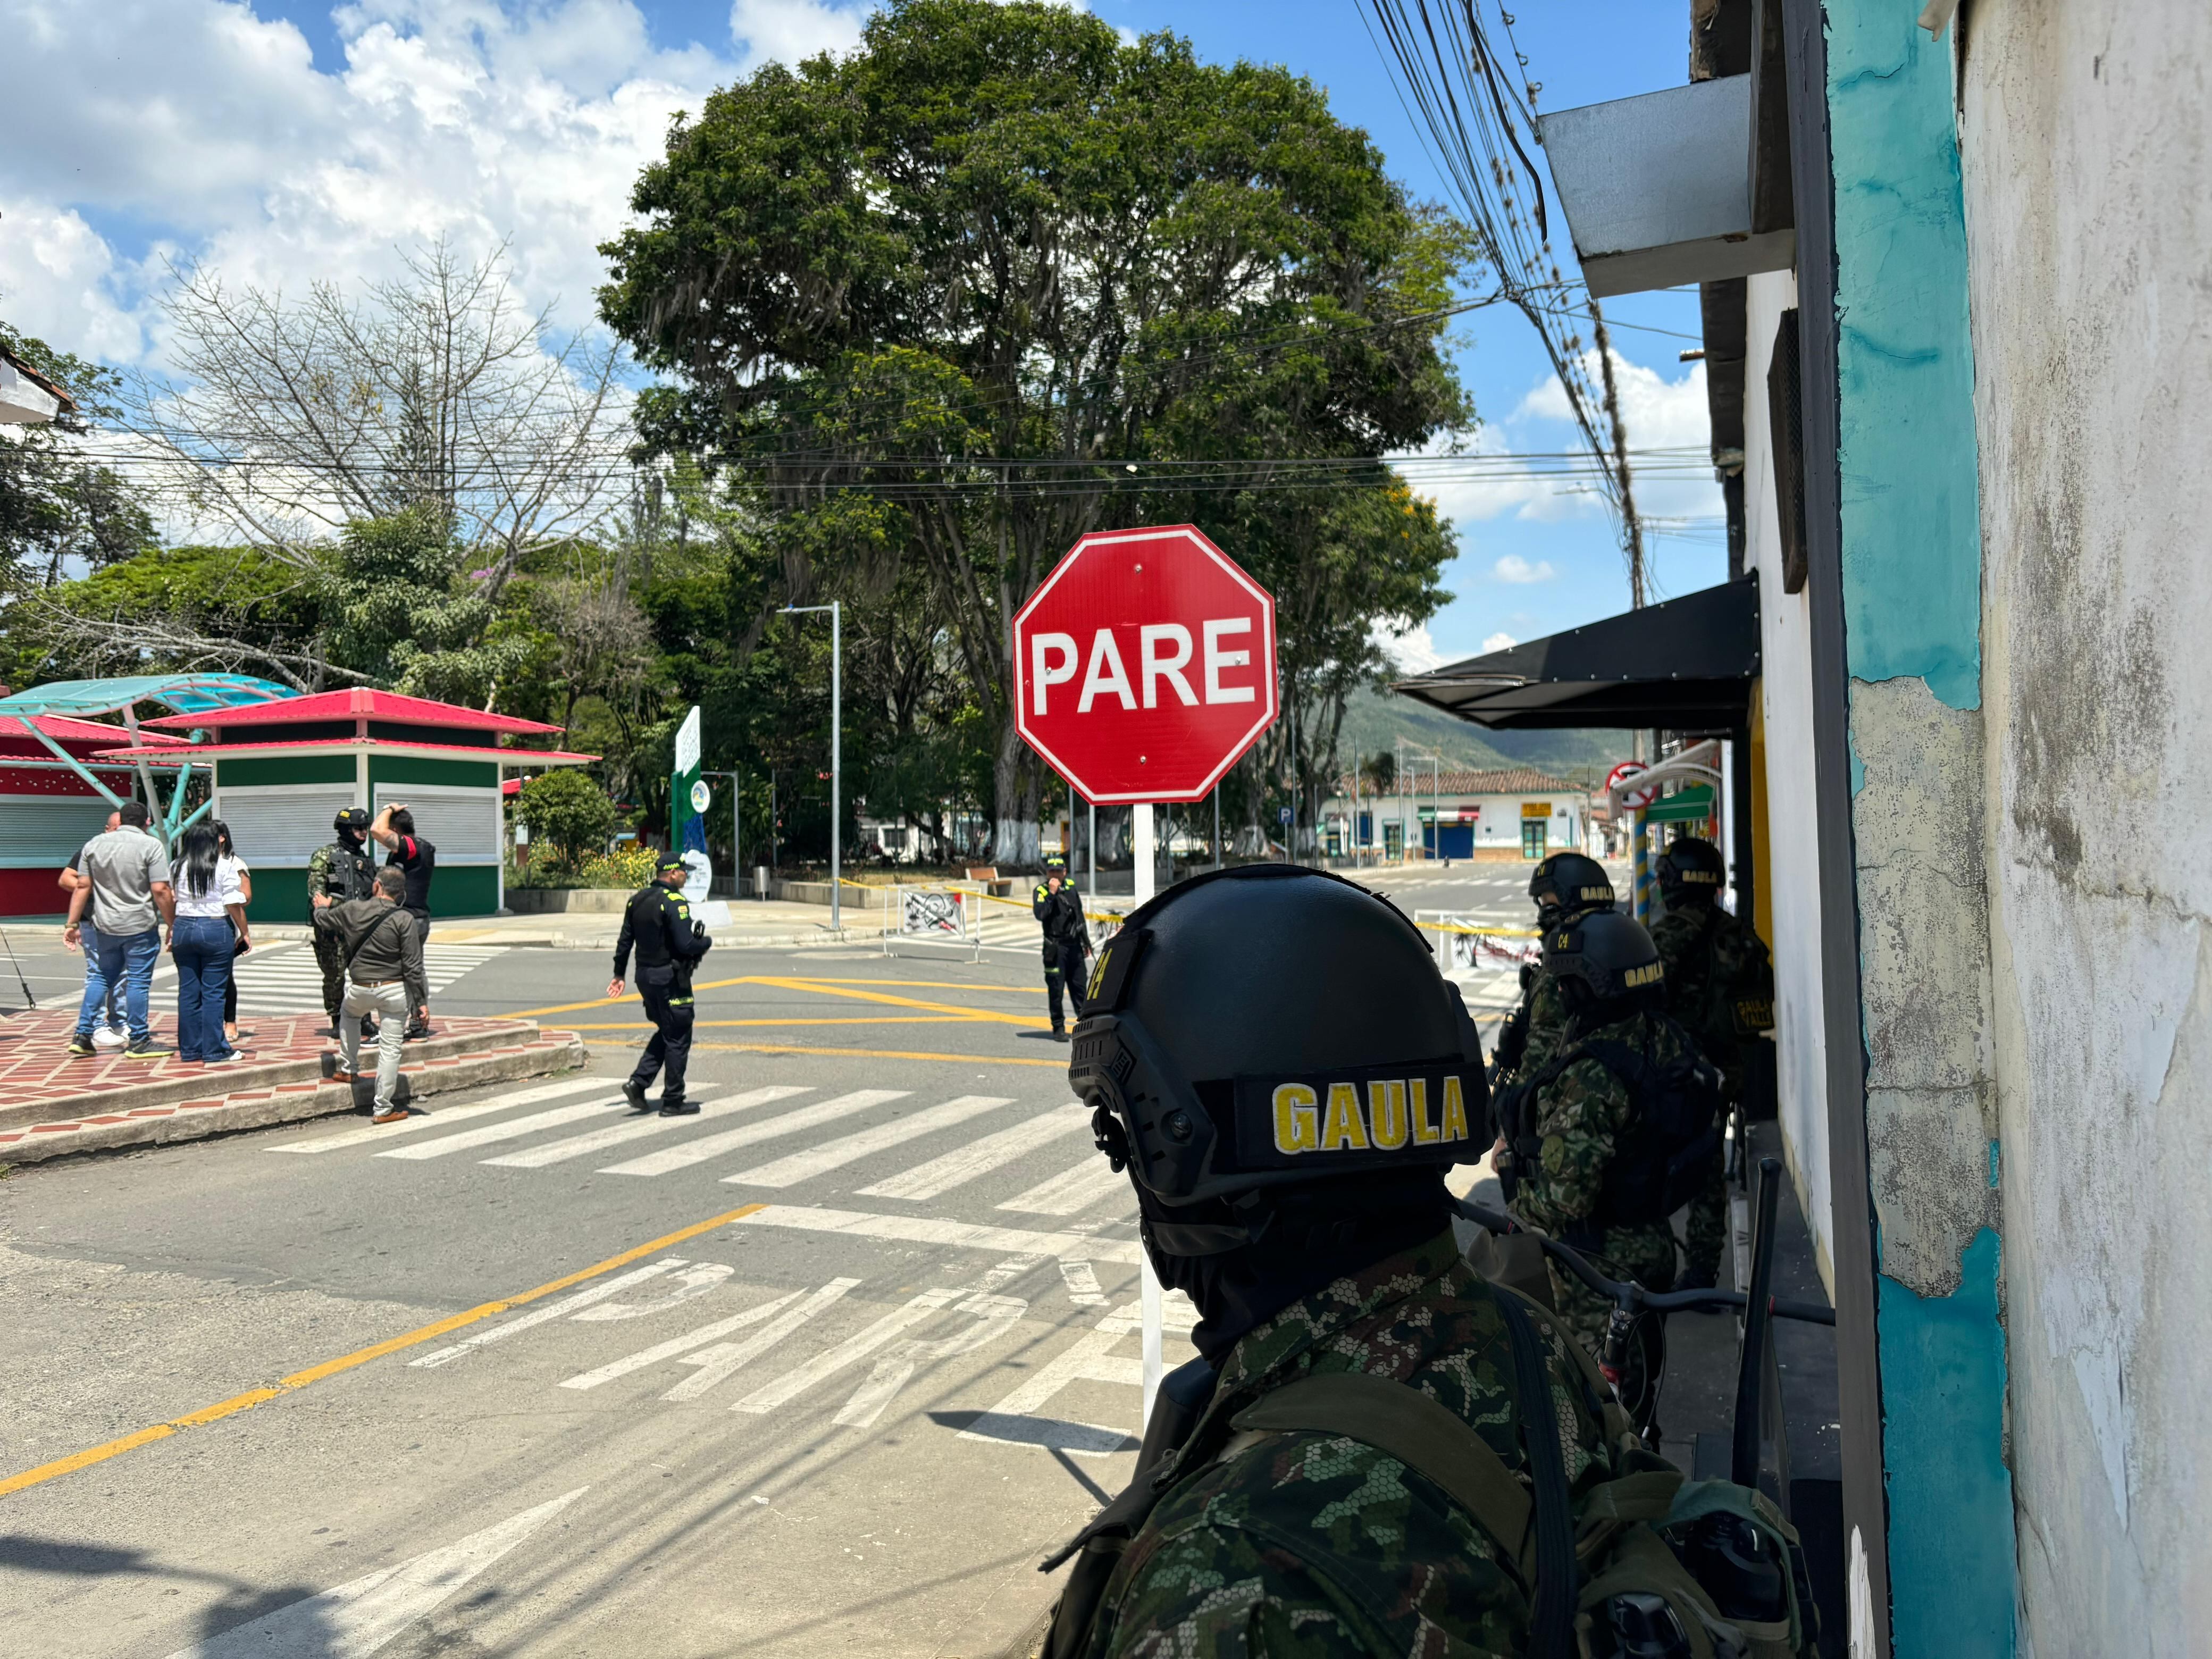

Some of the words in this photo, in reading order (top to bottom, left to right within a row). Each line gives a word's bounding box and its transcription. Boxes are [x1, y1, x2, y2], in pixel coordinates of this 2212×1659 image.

[1031, 617, 1255, 716] PARE
[1281, 808, 1291, 822] P
[1557, 933, 1569, 949] C4
[1272, 1075, 1469, 1155] GAULA
